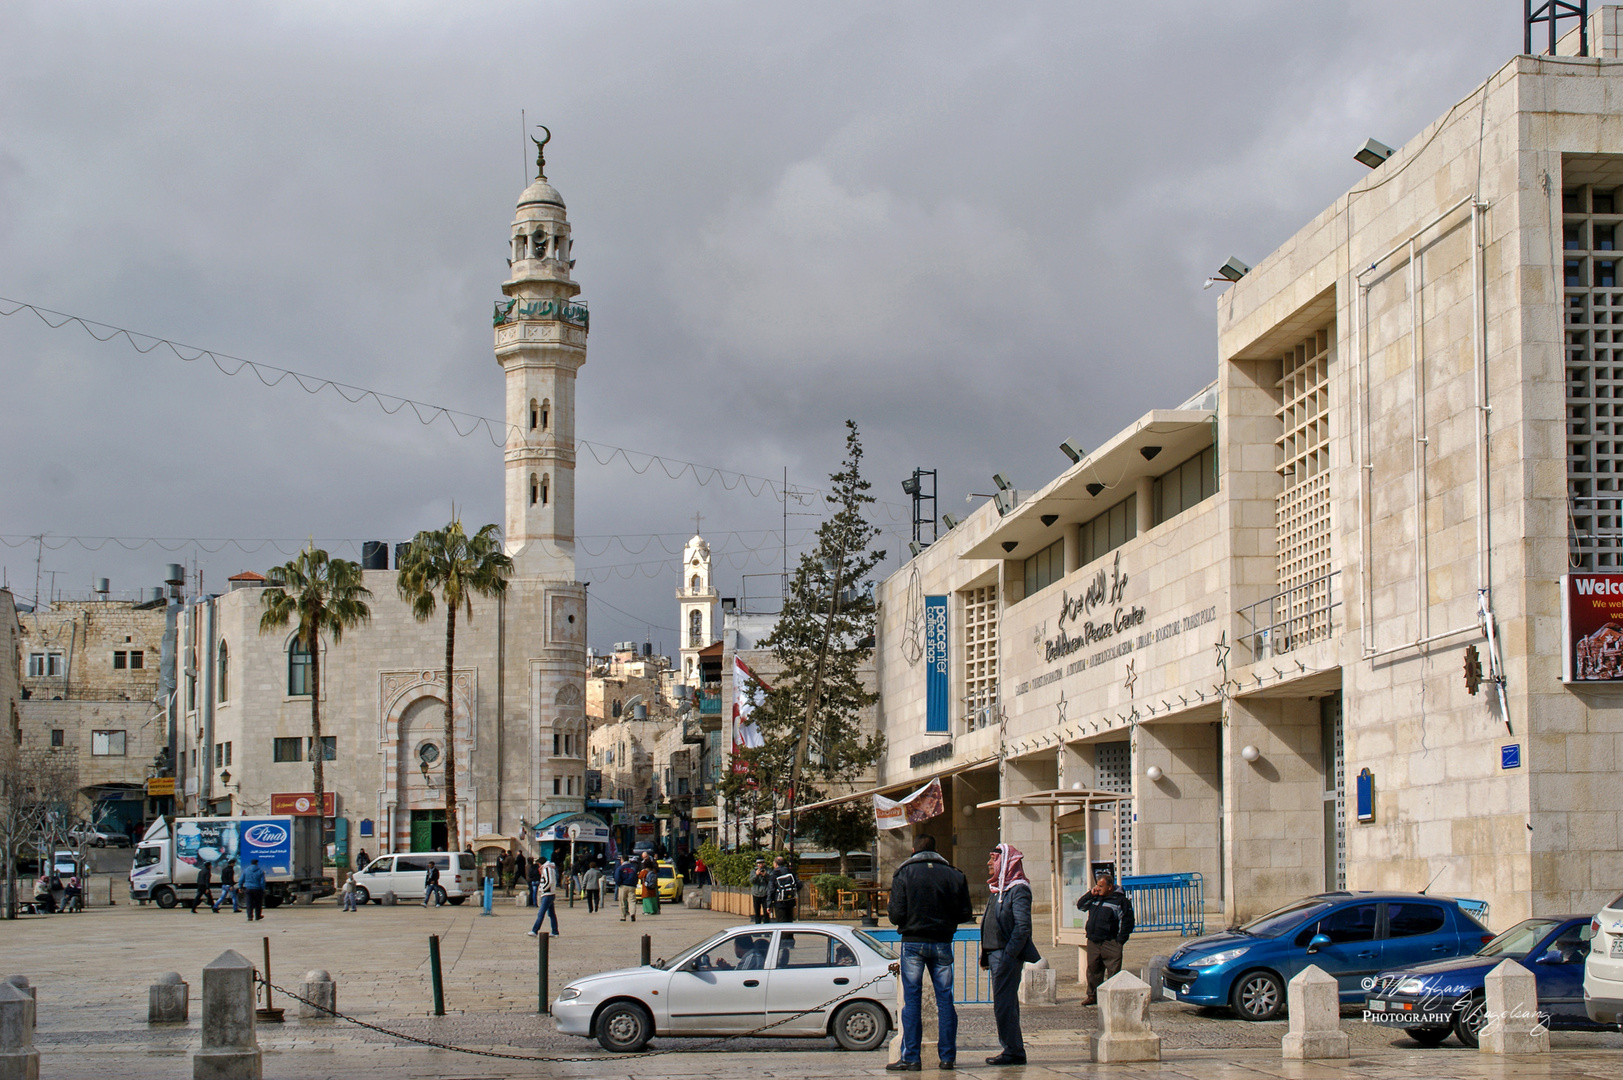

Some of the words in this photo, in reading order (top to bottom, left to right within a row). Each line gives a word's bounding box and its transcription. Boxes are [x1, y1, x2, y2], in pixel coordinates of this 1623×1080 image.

[1085, 569, 1107, 616] السلام
[1592, 600, 1606, 608] We
[926, 606, 935, 638] coffee
[933, 605, 949, 675] peacenter
[1045, 631, 1085, 664] Bethlehem
[1084, 621, 1114, 647] Peace
[1114, 606, 1146, 634] Center
[927, 638, 936, 664] shop
